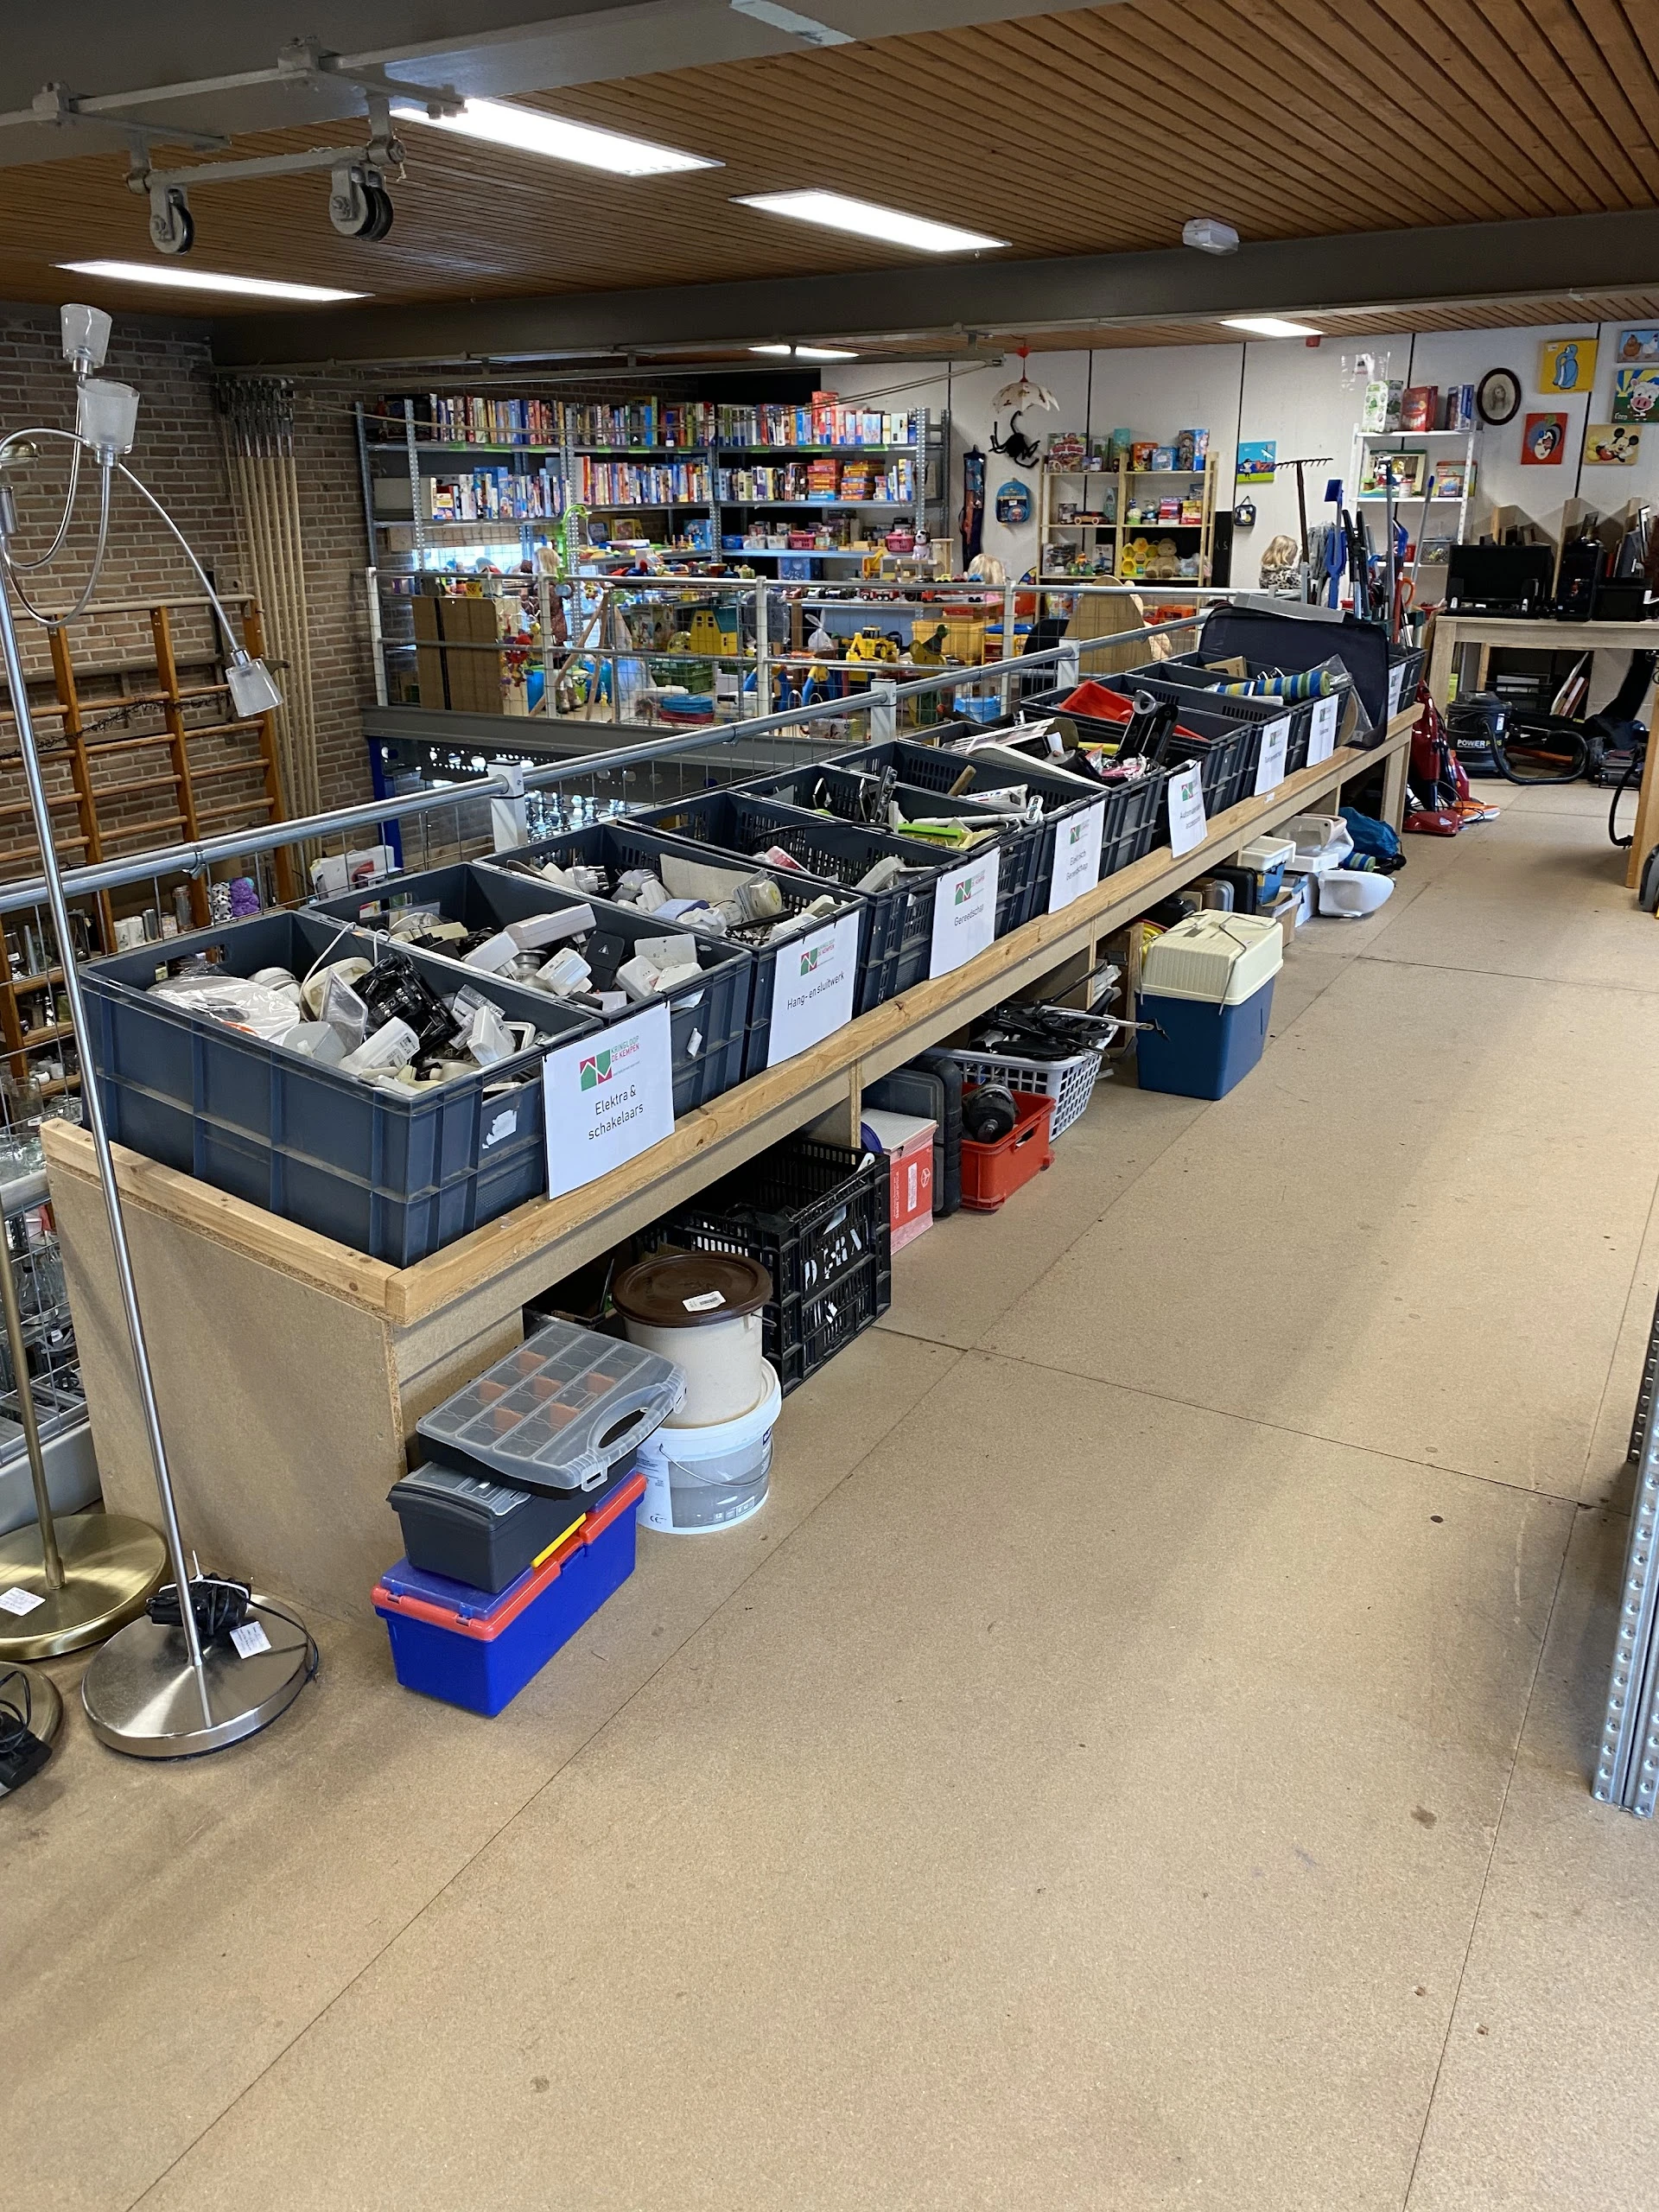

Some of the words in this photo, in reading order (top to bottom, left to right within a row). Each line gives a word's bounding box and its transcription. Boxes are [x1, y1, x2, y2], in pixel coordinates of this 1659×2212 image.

[954, 904, 984, 926] Gereedschap
[787, 995, 808, 1009] Hang-
[809, 988, 817, 998] en
[817, 971, 844, 994] sluitwerk
[611, 1035, 639, 1052] KRINGLOOP
[611, 1052, 619, 1062] DE
[619, 1043, 639, 1058] KEMPEN
[595, 1091, 628, 1116] Elektra
[630, 1084, 637, 1096] &
[588, 1103, 644, 1140] schakelaars
